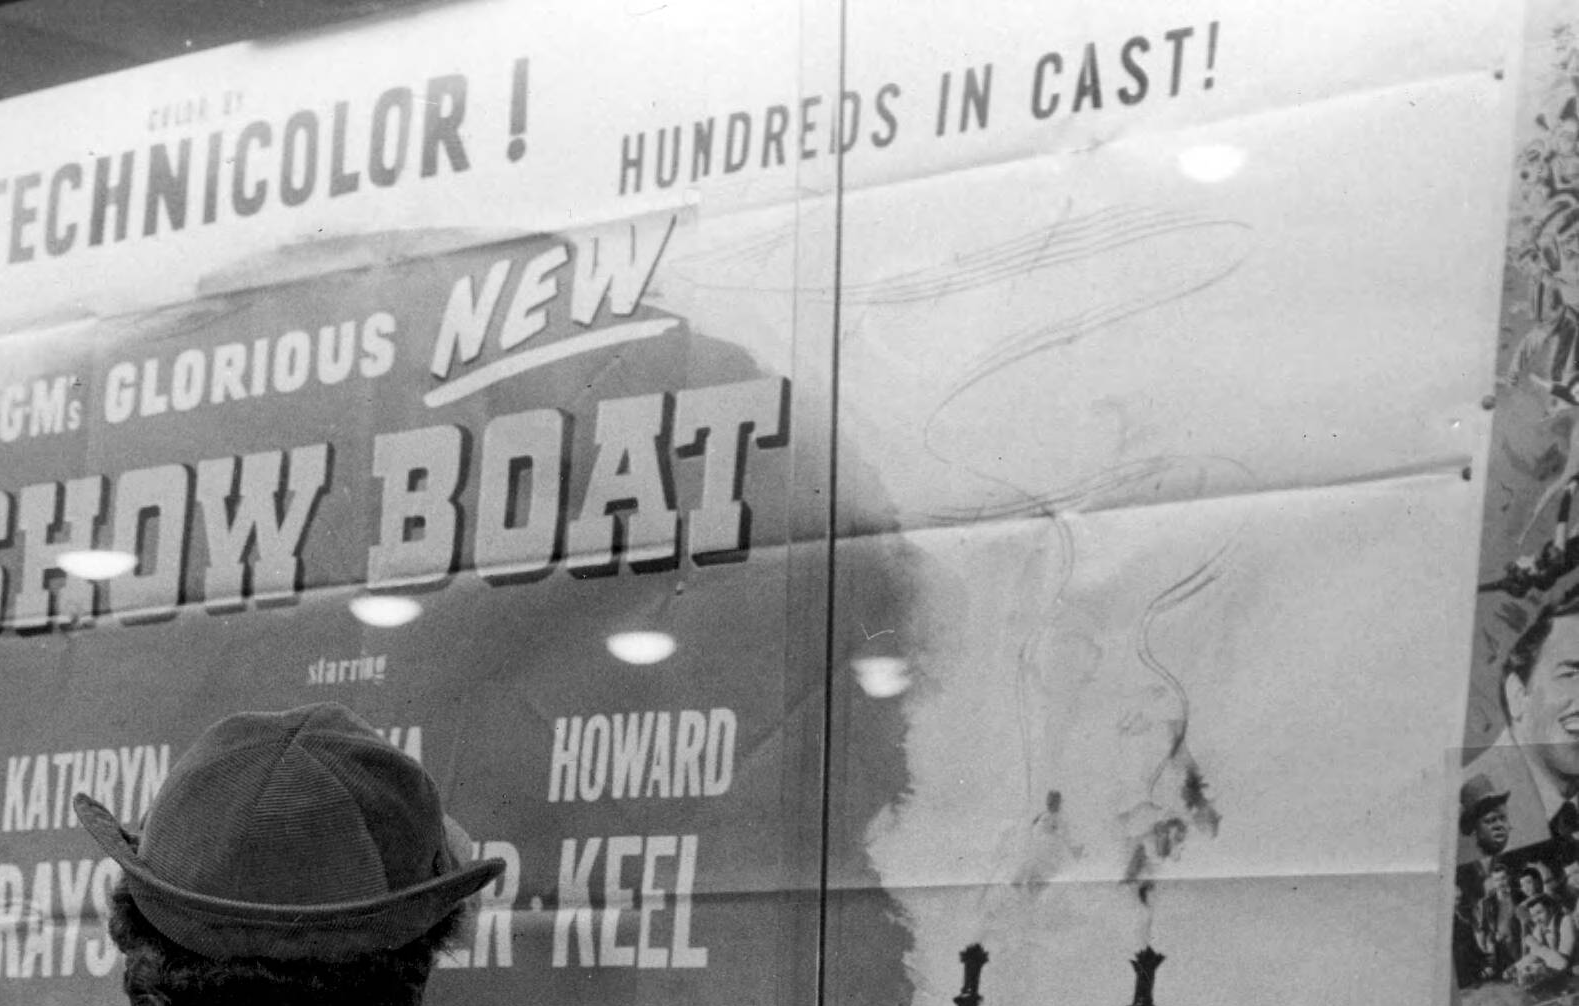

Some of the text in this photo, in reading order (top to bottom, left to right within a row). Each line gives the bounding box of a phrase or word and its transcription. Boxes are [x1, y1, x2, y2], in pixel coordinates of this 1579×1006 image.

[617, 21, 1219, 195] HUNDREDS IN CAST!
[104, 312, 396, 424] GLORIOUS
[430, 214, 677, 381] NEW
[366, 377, 792, 592] BOAT
[2, 744, 170, 832] KATHRYN
[548, 708, 738, 803] HOWARD
[552, 834, 709, 969] KEEL
